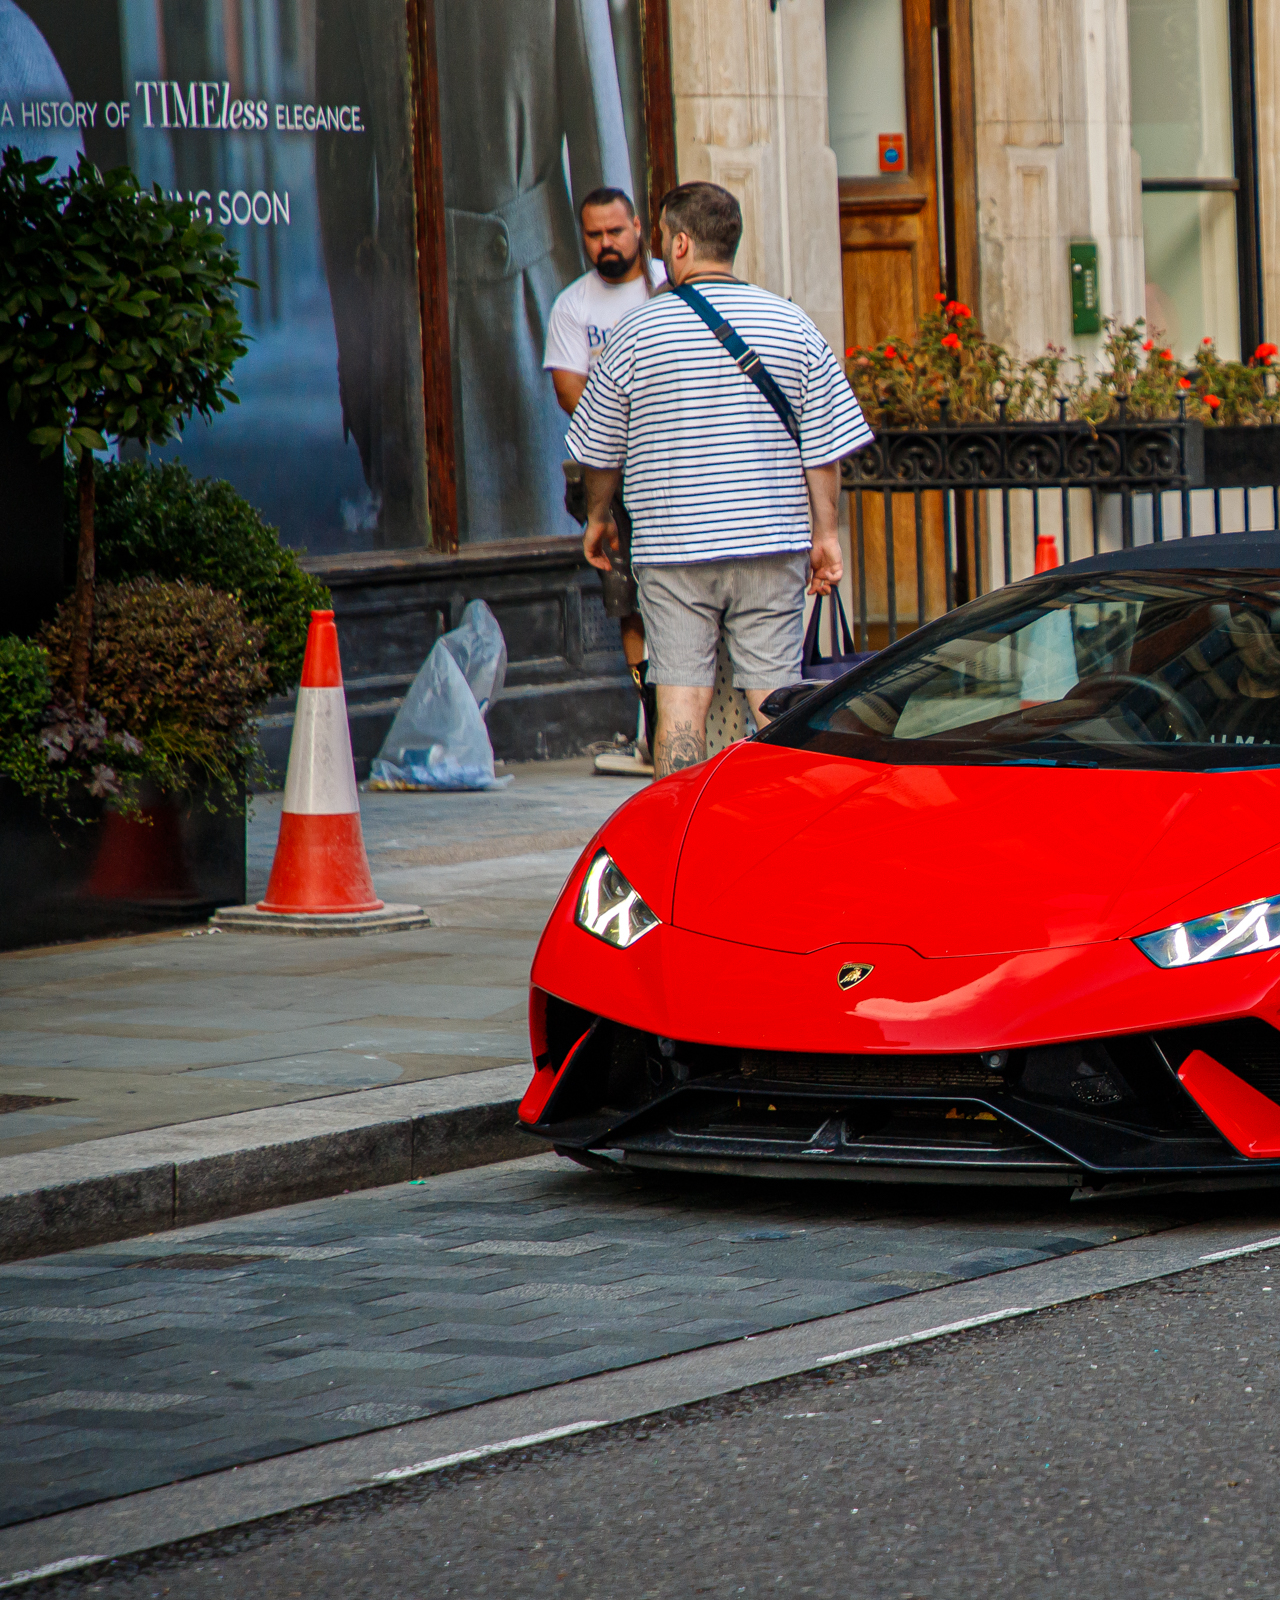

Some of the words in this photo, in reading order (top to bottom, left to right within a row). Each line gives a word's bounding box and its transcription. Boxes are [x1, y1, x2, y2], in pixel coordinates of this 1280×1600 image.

[1, 101, 15, 127] A
[21, 101, 98, 128] HISTORY
[105, 101, 130, 128] OF
[135, 81, 269, 130] TIMEless
[276, 104, 365, 132] ELEGANCE.
[218, 189, 290, 226] SOON
